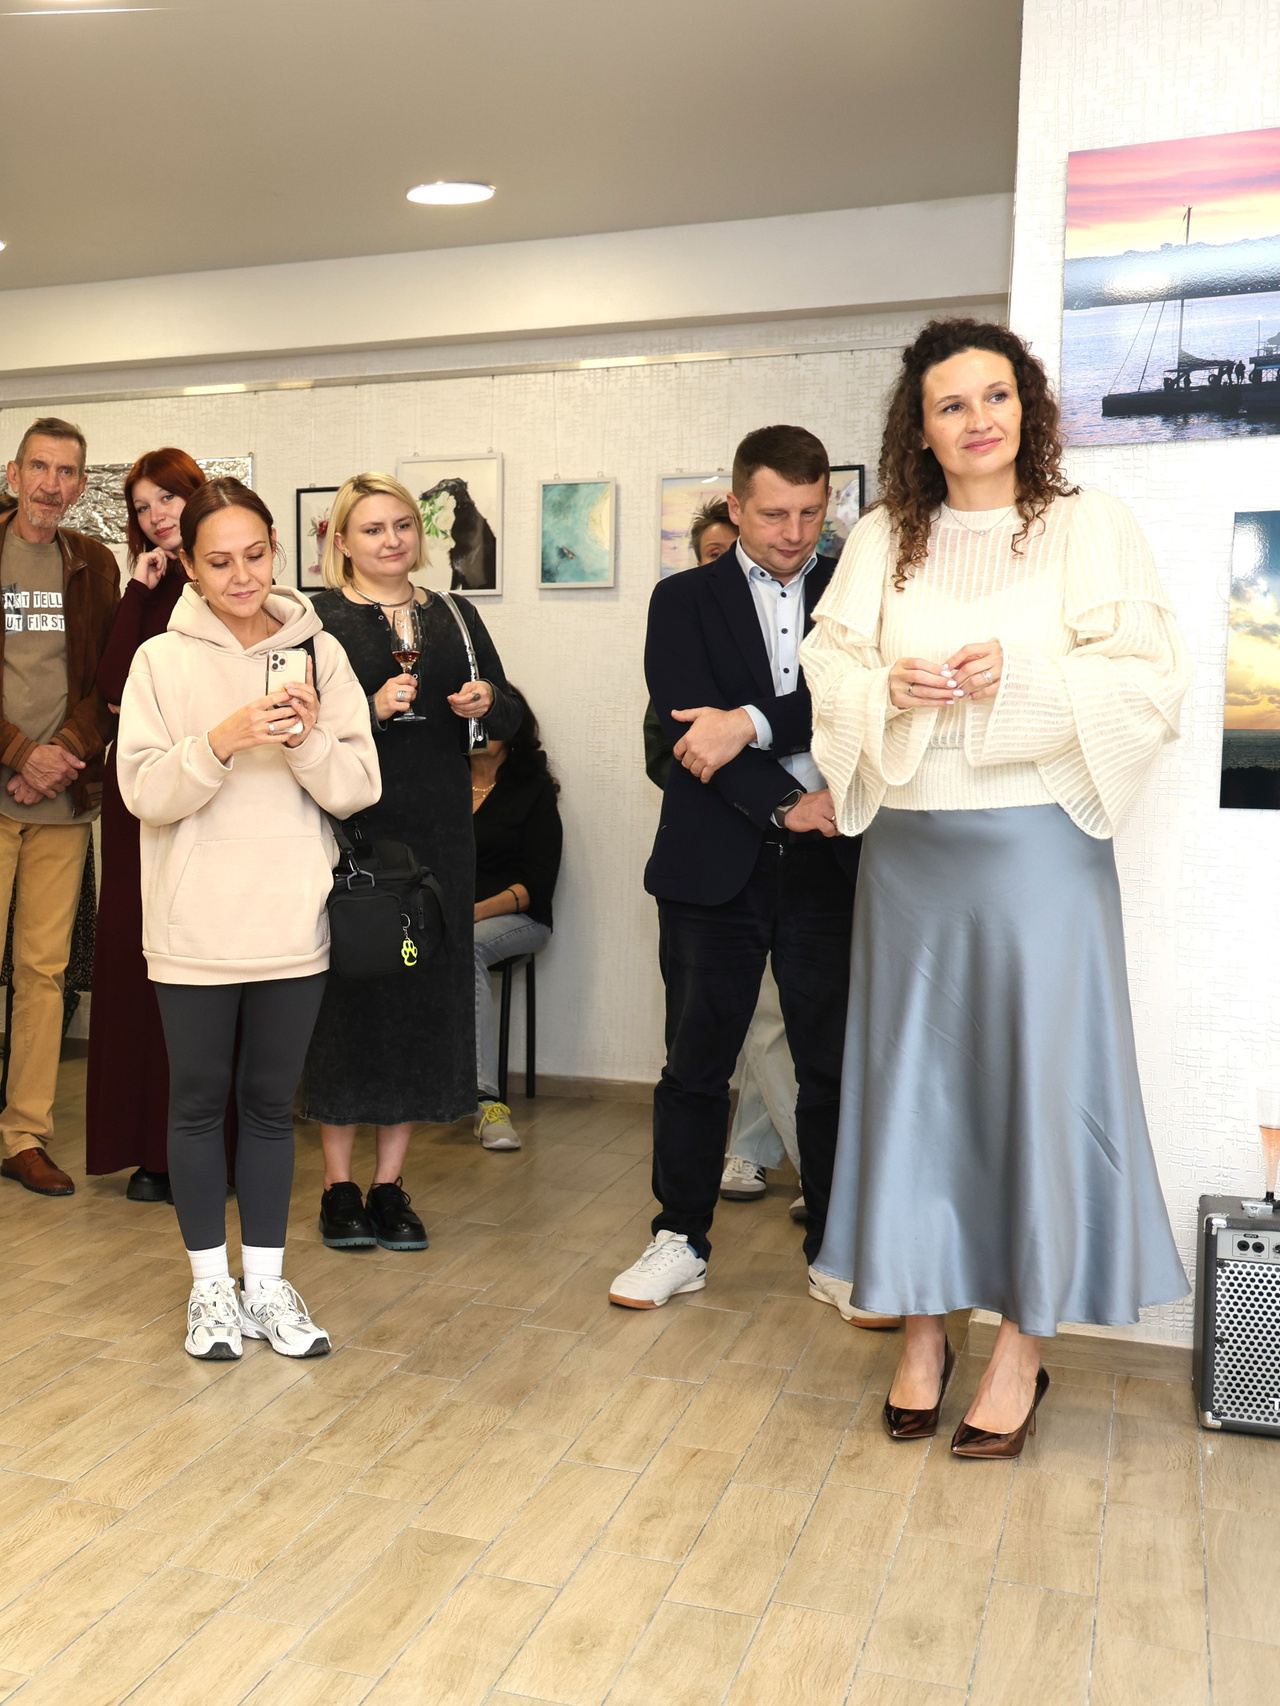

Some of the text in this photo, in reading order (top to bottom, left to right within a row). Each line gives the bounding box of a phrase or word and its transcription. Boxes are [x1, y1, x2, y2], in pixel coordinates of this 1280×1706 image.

[34, 592, 62, 607] TELL
[6, 615, 65, 630] UT FIRST
